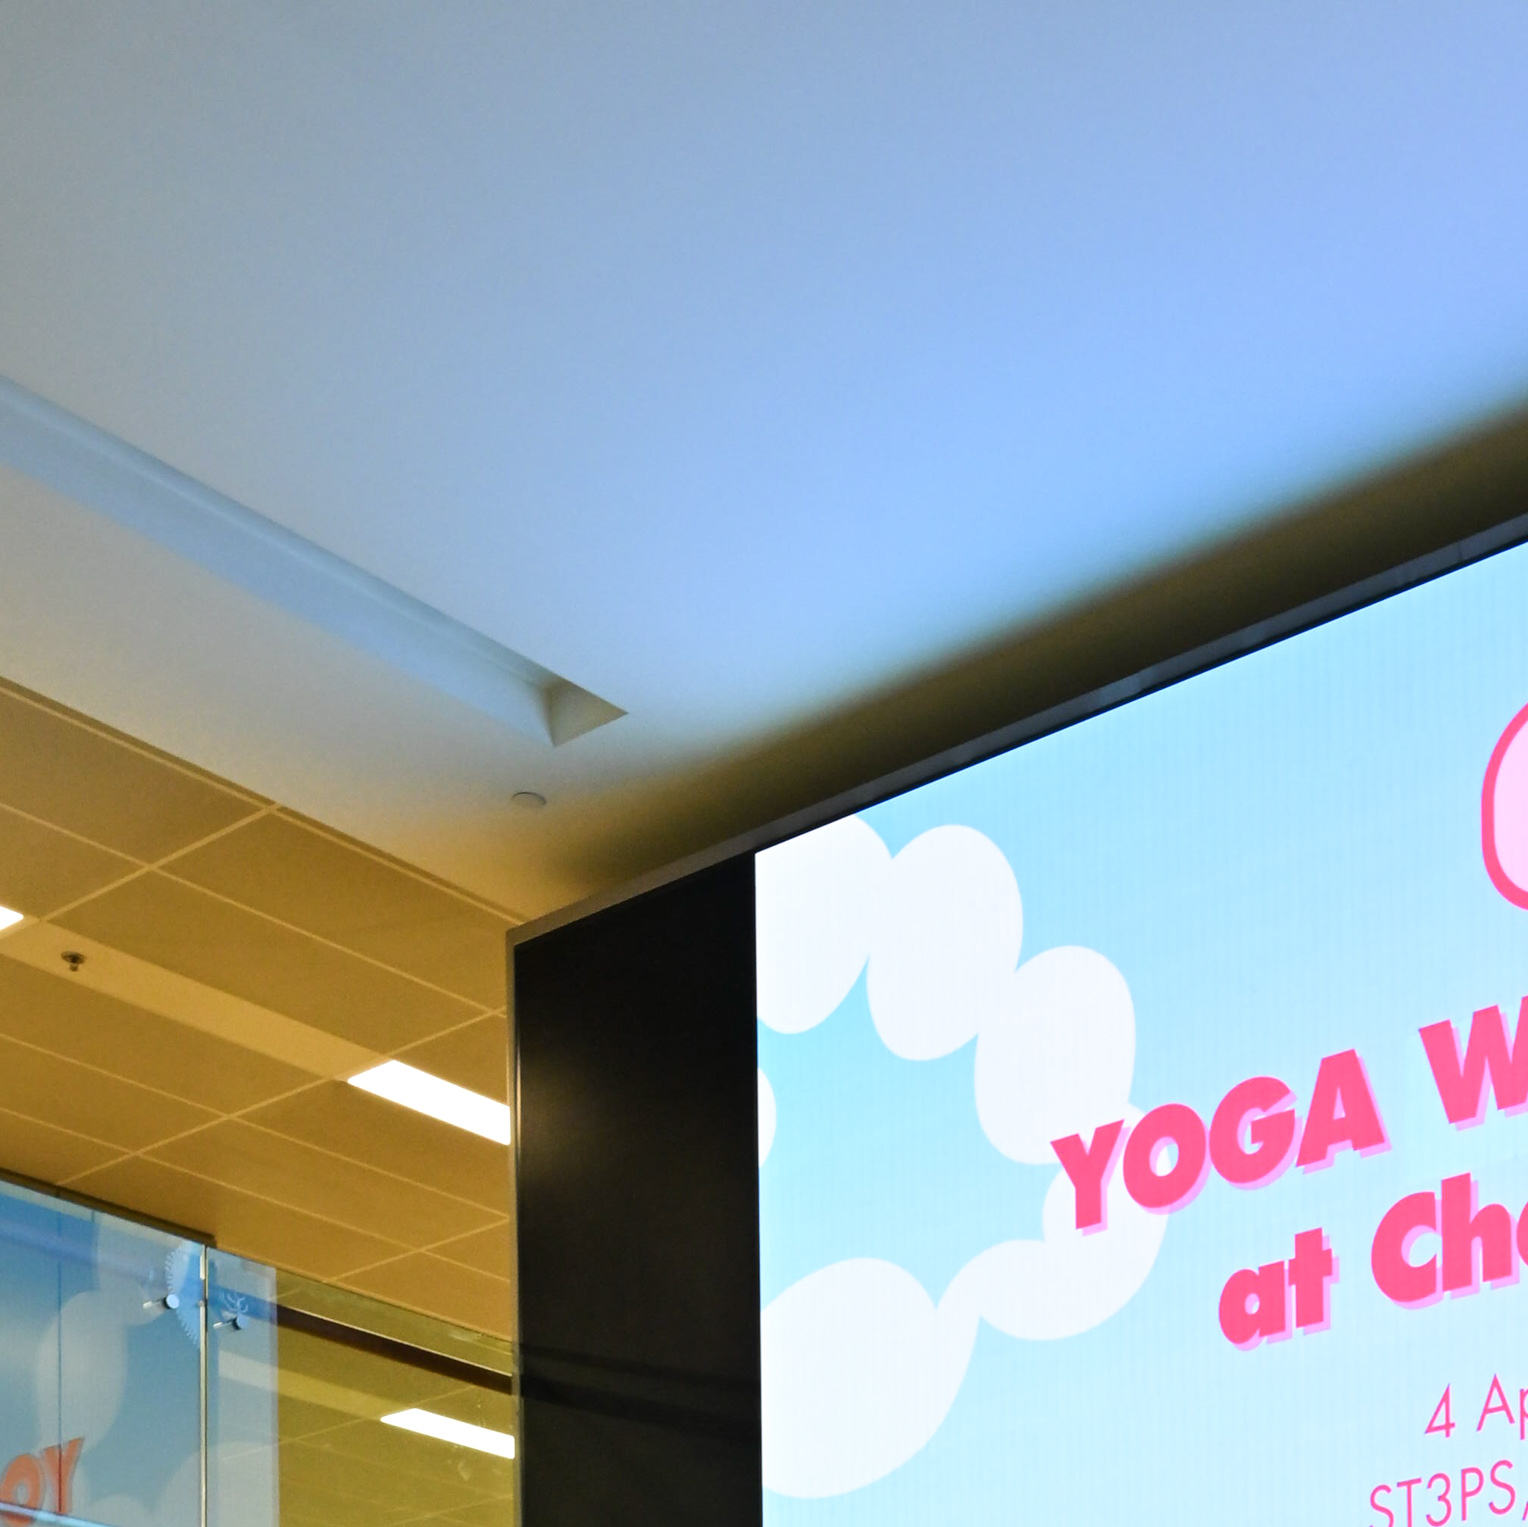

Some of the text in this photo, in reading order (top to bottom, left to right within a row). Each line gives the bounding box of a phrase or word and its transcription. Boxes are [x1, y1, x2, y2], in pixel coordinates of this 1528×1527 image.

[1051, 1048, 1388, 1231] YOGA
[1218, 1227, 1337, 1347] at
[1425, 1385, 1456, 1438] 4
